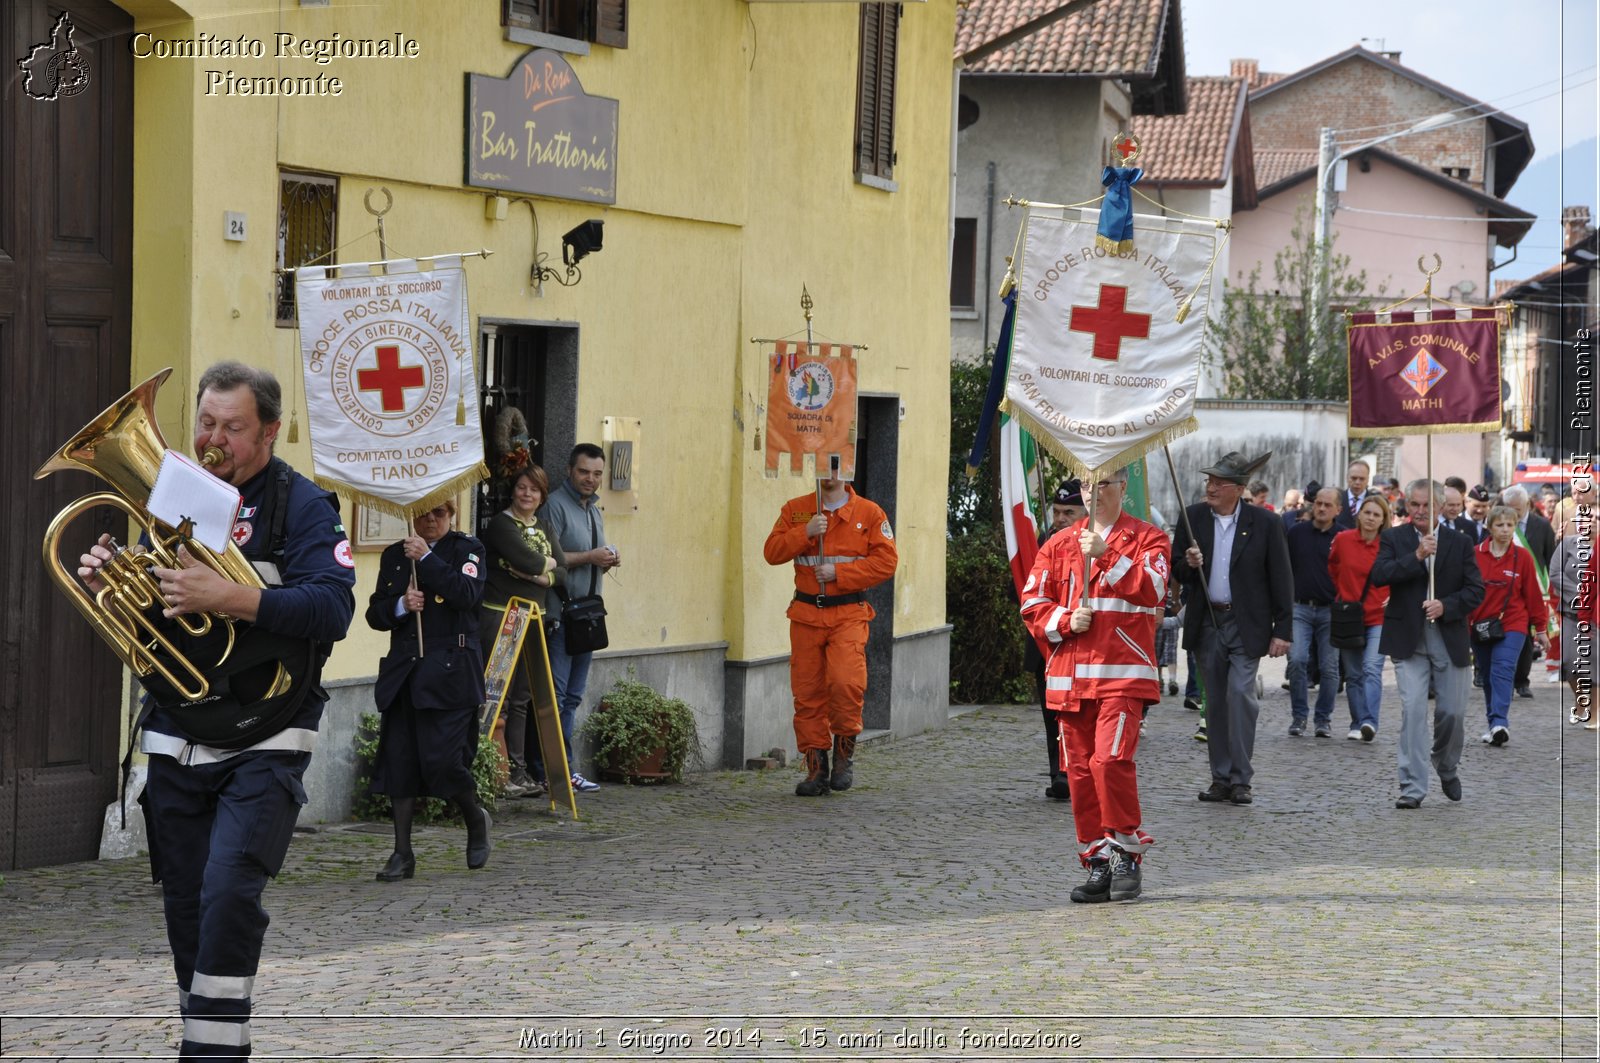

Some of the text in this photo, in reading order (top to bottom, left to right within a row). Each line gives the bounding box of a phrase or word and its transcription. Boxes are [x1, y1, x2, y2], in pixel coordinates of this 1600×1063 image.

[524, 61, 573, 99] Da Rosa
[481, 111, 608, 171] Bar Trattoria
[231, 220, 245, 235] 24
[321, 280, 442, 302] VOLONTARI DEL SOCCORSO
[1033, 253, 1079, 302] CROCE
[1143, 254, 1191, 309] ITALIAN
[309, 299, 467, 374] CROCE ROSSA ITALIANA
[1368, 334, 1481, 370] A.V.I.S. COMUNALE
[335, 323, 445, 431] CONVENZIONE DI GINEVRA 22 AGOSTO 1864
[1039, 366, 1168, 389] VOLONTARI DEL SOCCORSO
[1018, 372, 1187, 438] SAN FRANCESCO AL CAMPO
[1402, 398, 1443, 411] MATHI
[787, 412, 833, 423] SQUADRA DI
[796, 425, 822, 433] MATHI
[336, 441, 460, 464] COMITATO LOCALE
[371, 463, 428, 481] FIANO
